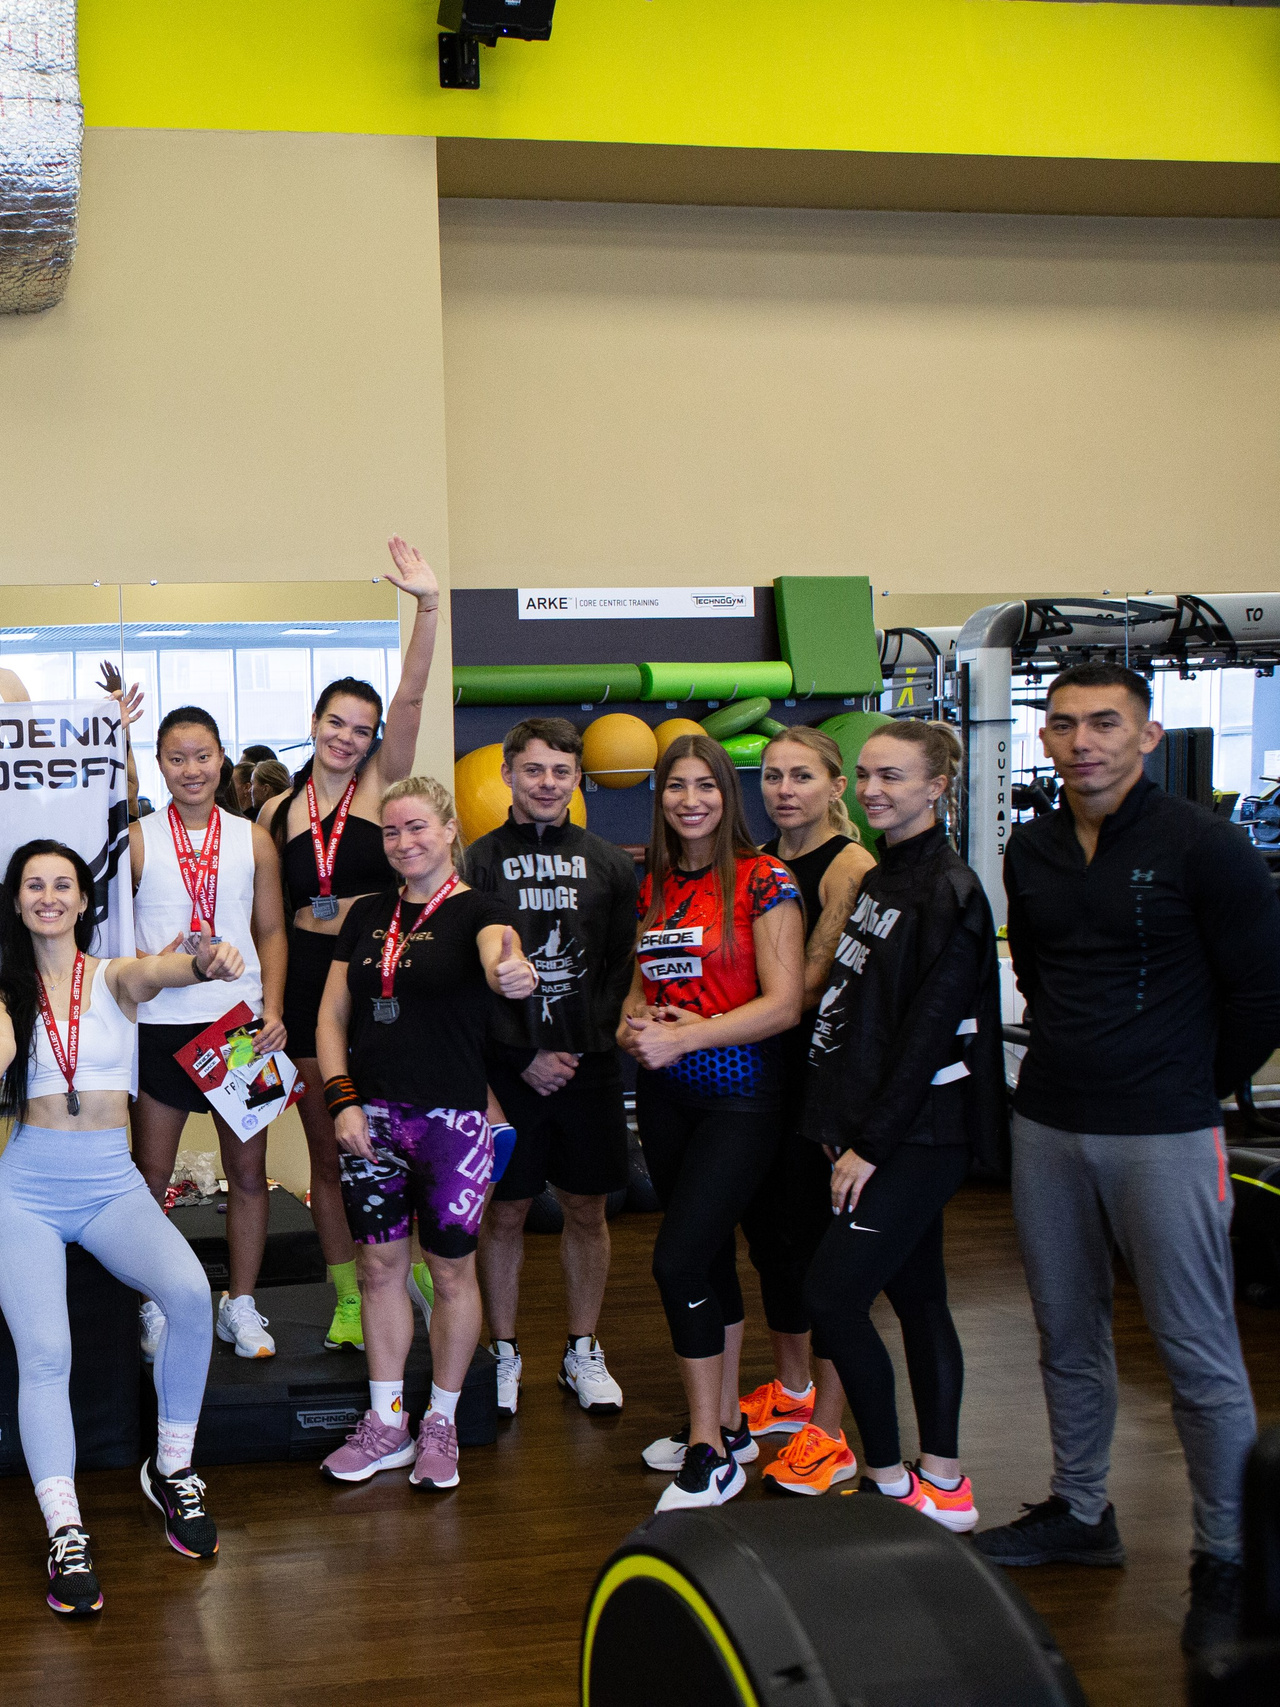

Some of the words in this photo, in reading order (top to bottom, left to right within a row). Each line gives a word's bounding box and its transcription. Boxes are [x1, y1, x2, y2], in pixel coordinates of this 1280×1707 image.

[526, 598, 568, 610] ARKE
[579, 599, 598, 607] CORE
[599, 599, 628, 607] CENTRIC
[628, 598, 660, 607] TRAINING
[308, 784, 316, 818] ФИНИШЕР
[168, 808, 184, 853] CHAMPIONSHIP
[204, 811, 218, 856] CHAMPIONSHIP
[336, 822, 344, 834] OCR
[314, 838, 326, 878] ФИНИШЕР
[502, 853, 588, 882] СУДЬЯ
[424, 884, 452, 916] ФИНИШЕР
[518, 886, 578, 912] JUDGE
[640, 931, 694, 949] PRIDE
[383, 938, 394, 976] ФИНИШЕР
[648, 961, 693, 978] TEAM
[73, 962, 82, 1000] ФИНИШЕР
[540, 982, 572, 993] RACE
[49, 1030, 66, 1072] ФИНИШЕР
[70, 1026, 78, 1070] ФИНИШЕР
[298, 1411, 361, 1425] TECHNOGY
